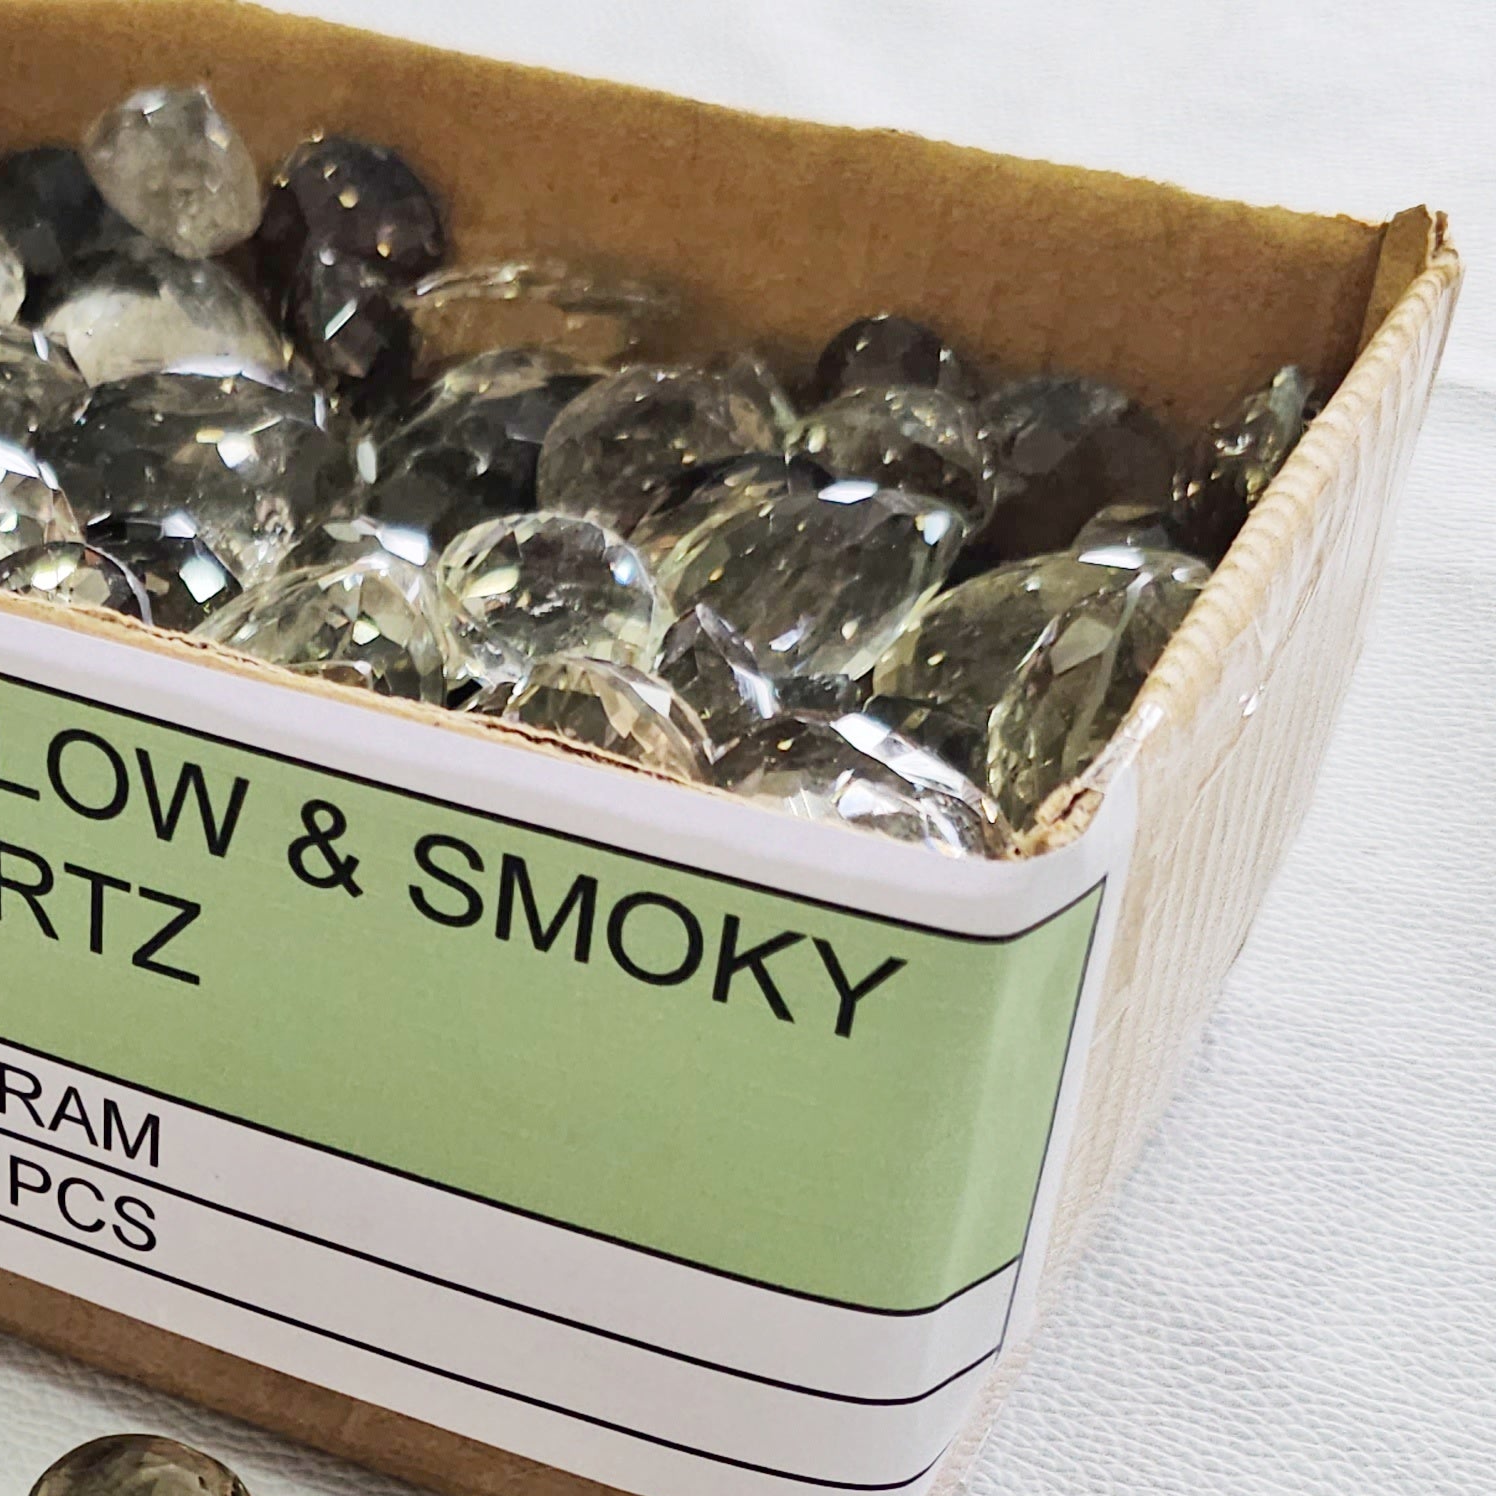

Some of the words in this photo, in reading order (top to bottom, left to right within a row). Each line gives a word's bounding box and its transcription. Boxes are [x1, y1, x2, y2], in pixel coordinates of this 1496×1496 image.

[287, 798, 365, 898] &
[408, 833, 908, 1039] SMOKY
[9, 1154, 158, 1252] PCS
